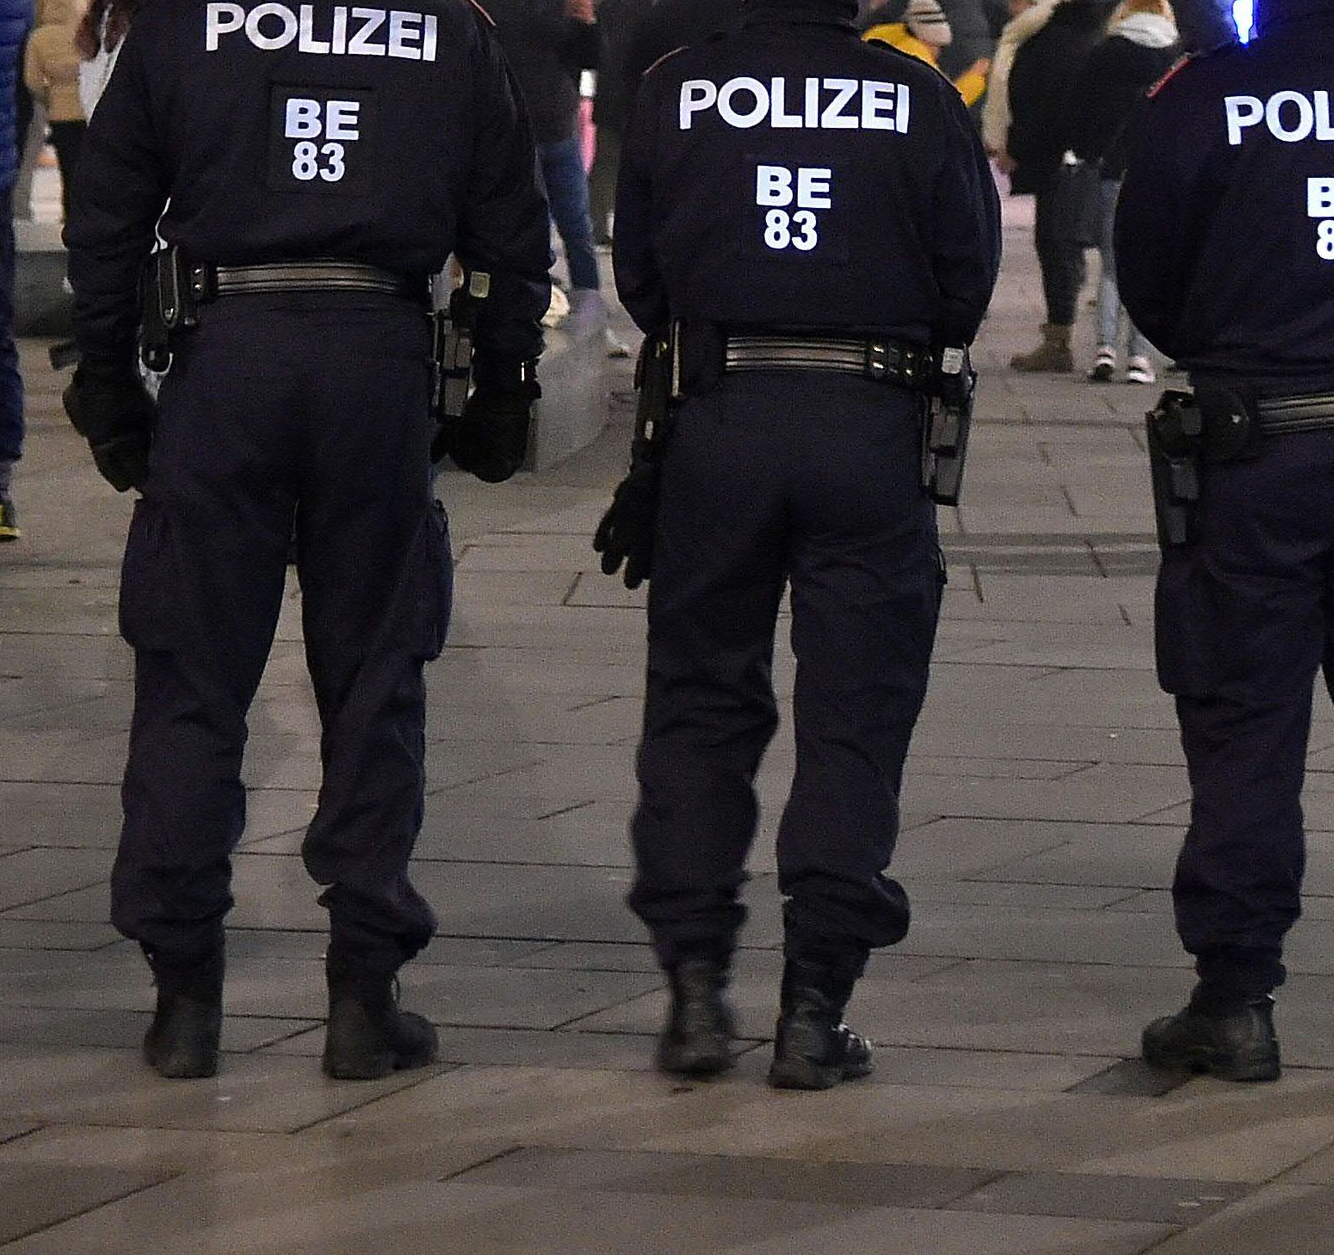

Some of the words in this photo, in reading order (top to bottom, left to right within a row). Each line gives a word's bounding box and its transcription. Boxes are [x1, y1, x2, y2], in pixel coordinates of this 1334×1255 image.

[207, 2, 438, 61] POLIZEI
[284, 98, 361, 141] BE
[679, 76, 910, 134] POLIZEI
[292, 141, 346, 183] 83
[756, 165, 832, 209] BE
[763, 209, 818, 251] 83
